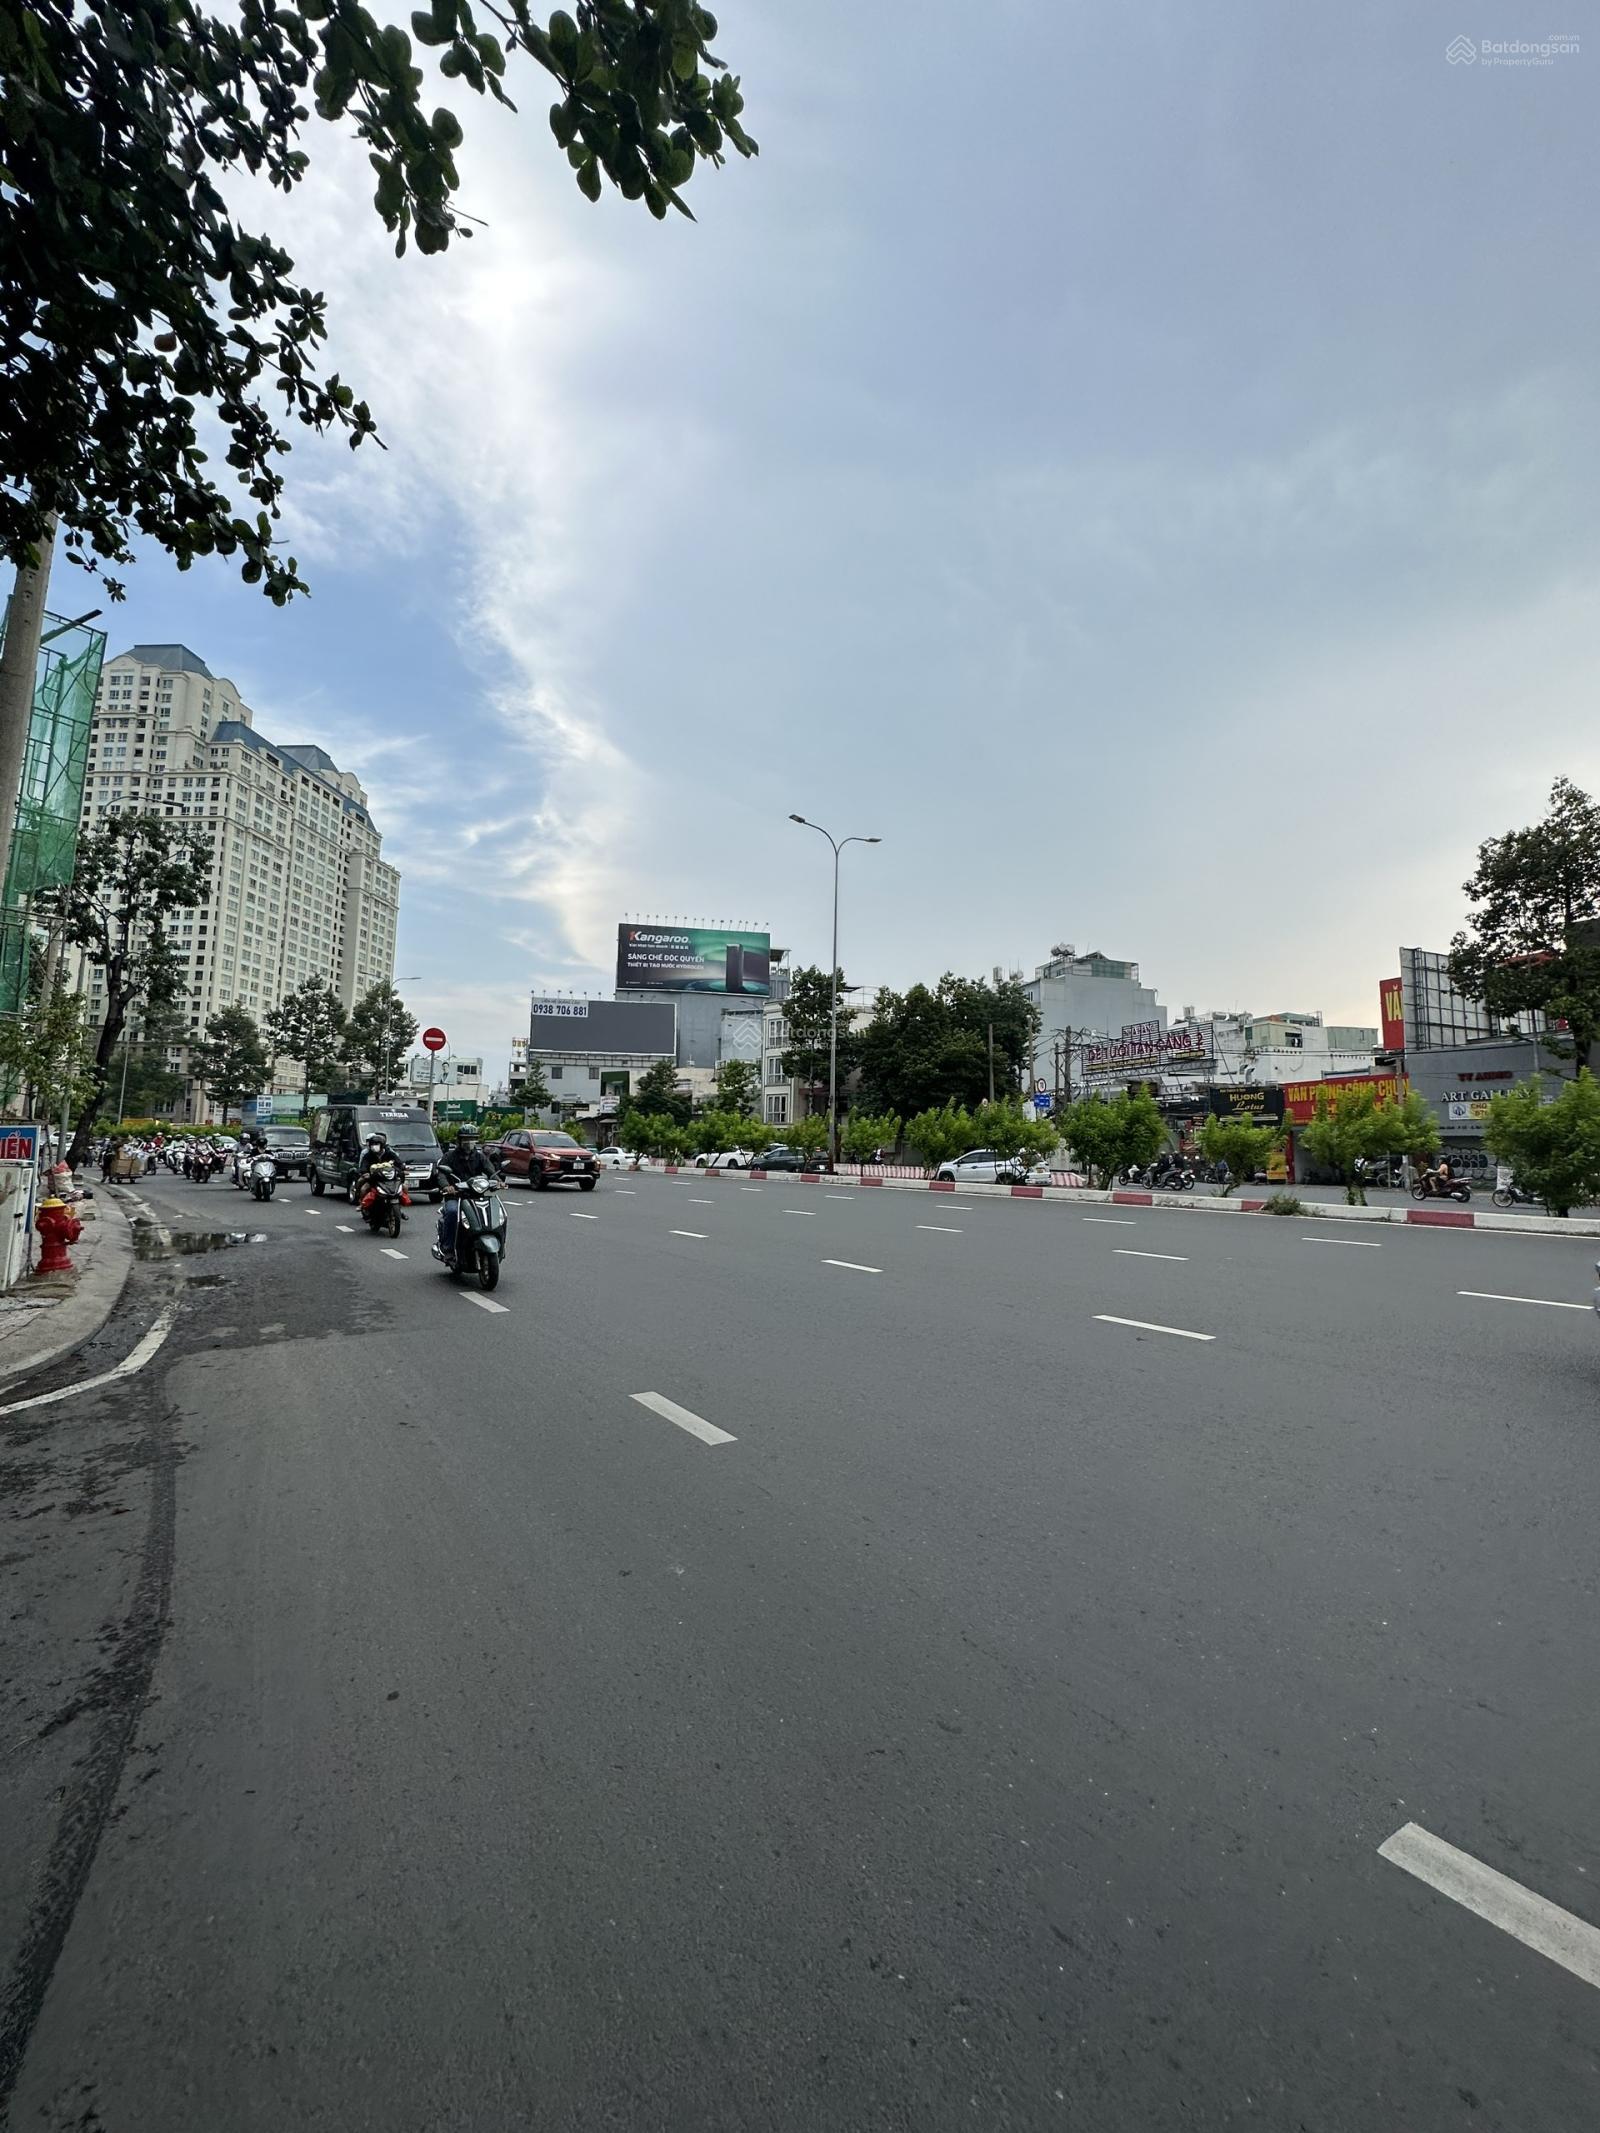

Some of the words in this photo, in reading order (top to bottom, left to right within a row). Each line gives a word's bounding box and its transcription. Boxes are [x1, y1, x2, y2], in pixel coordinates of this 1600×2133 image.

[629, 931, 689, 944] Kangaroo
[1385, 983, 1403, 1021] VĂ
[533, 1004, 554, 1014] 0938
[556, 1005, 571, 1016] 706
[573, 1006, 587, 1016] 881
[1288, 1084, 1307, 1102] VĂN
[1441, 1091, 1467, 1102] ART
